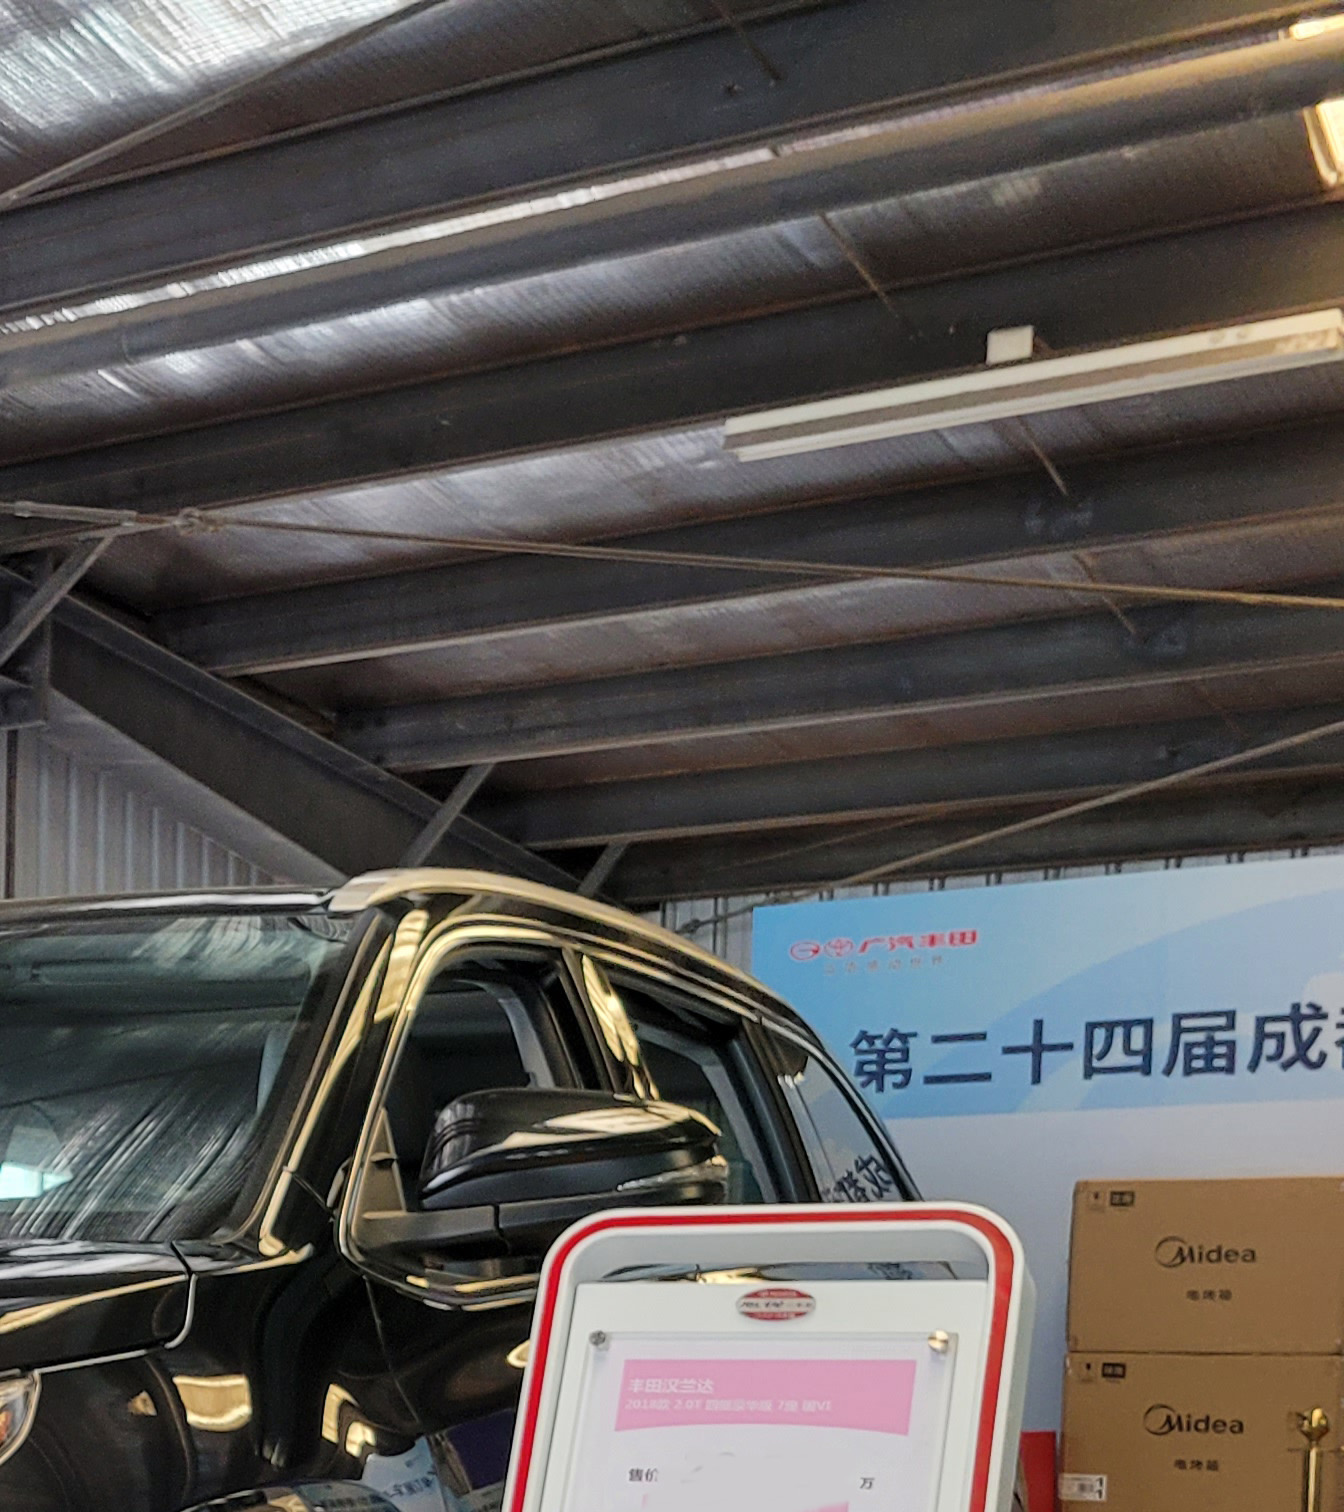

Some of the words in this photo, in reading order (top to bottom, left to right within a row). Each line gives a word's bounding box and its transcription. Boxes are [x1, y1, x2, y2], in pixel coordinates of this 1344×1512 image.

[849, 1002, 1344, 1094] 第二十四届成
[1165, 1242, 1257, 1267] Midea
[628, 1377, 715, 1395] 丰田汉兰达
[1154, 1409, 1245, 1434] Midea
[860, 1476, 875, 1490] 万
